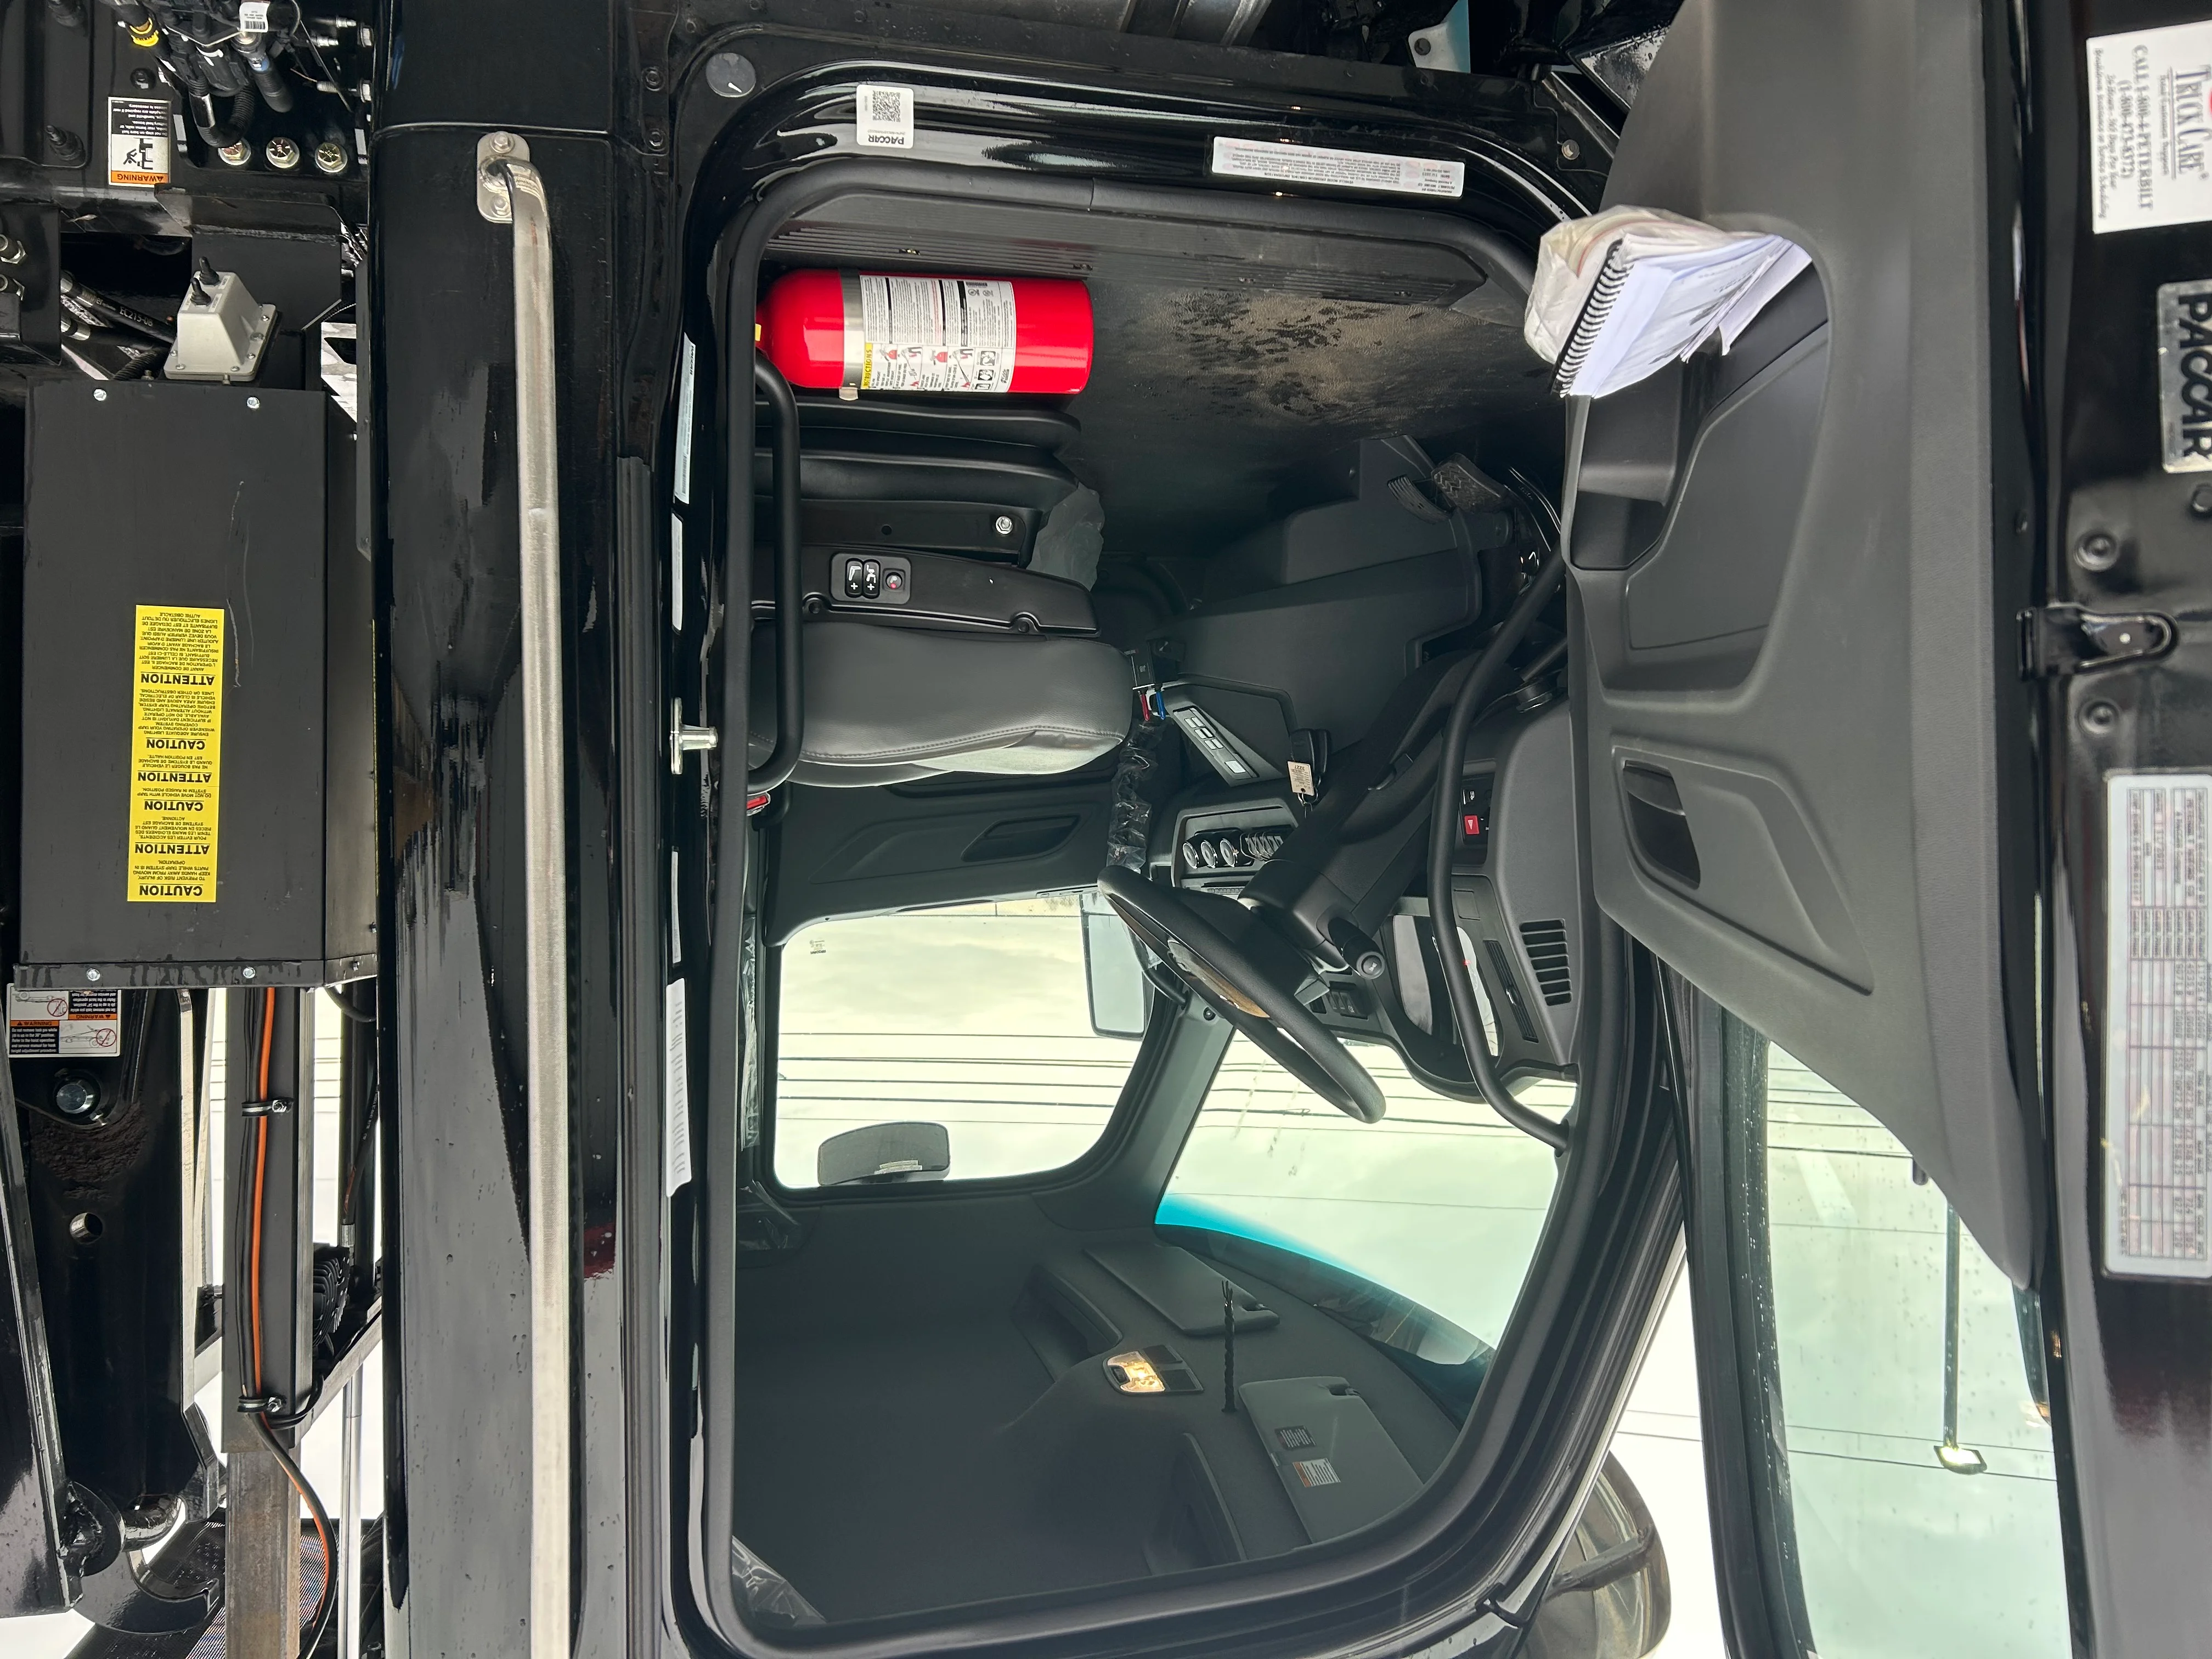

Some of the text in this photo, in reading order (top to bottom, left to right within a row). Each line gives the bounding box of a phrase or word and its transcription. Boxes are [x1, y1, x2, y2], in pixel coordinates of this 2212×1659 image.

[2132, 45, 2149, 83] CALL
[868, 134, 904, 145] PACCAR
[117, 174, 157, 182] WARNING
[140, 673, 215, 685] ATTENTION
[146, 739, 205, 749] CAUTION
[138, 772, 211, 782] ATTENTION
[144, 800, 203, 811] CAUTION
[134, 844, 210, 854] ATTENTION
[139, 885, 202, 896] CAUTION
